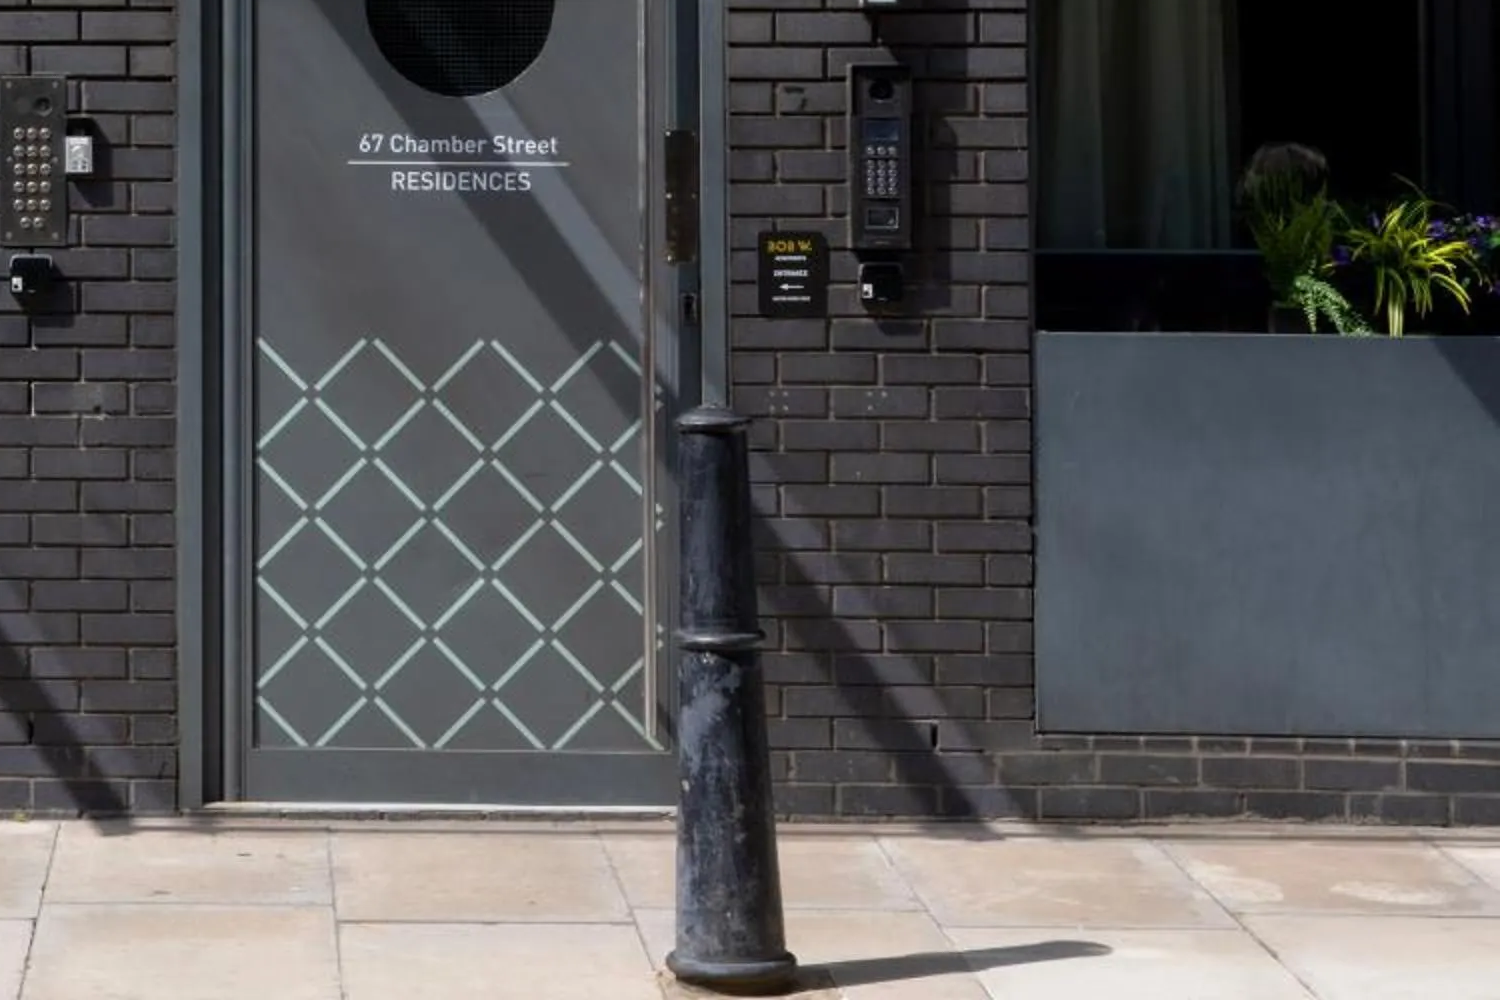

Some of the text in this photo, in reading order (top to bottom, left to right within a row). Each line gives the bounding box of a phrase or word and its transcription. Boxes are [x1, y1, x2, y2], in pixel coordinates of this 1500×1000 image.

[359, 133, 558, 154] 67 Chamber Street
[391, 171, 532, 191] RESIDENCES
